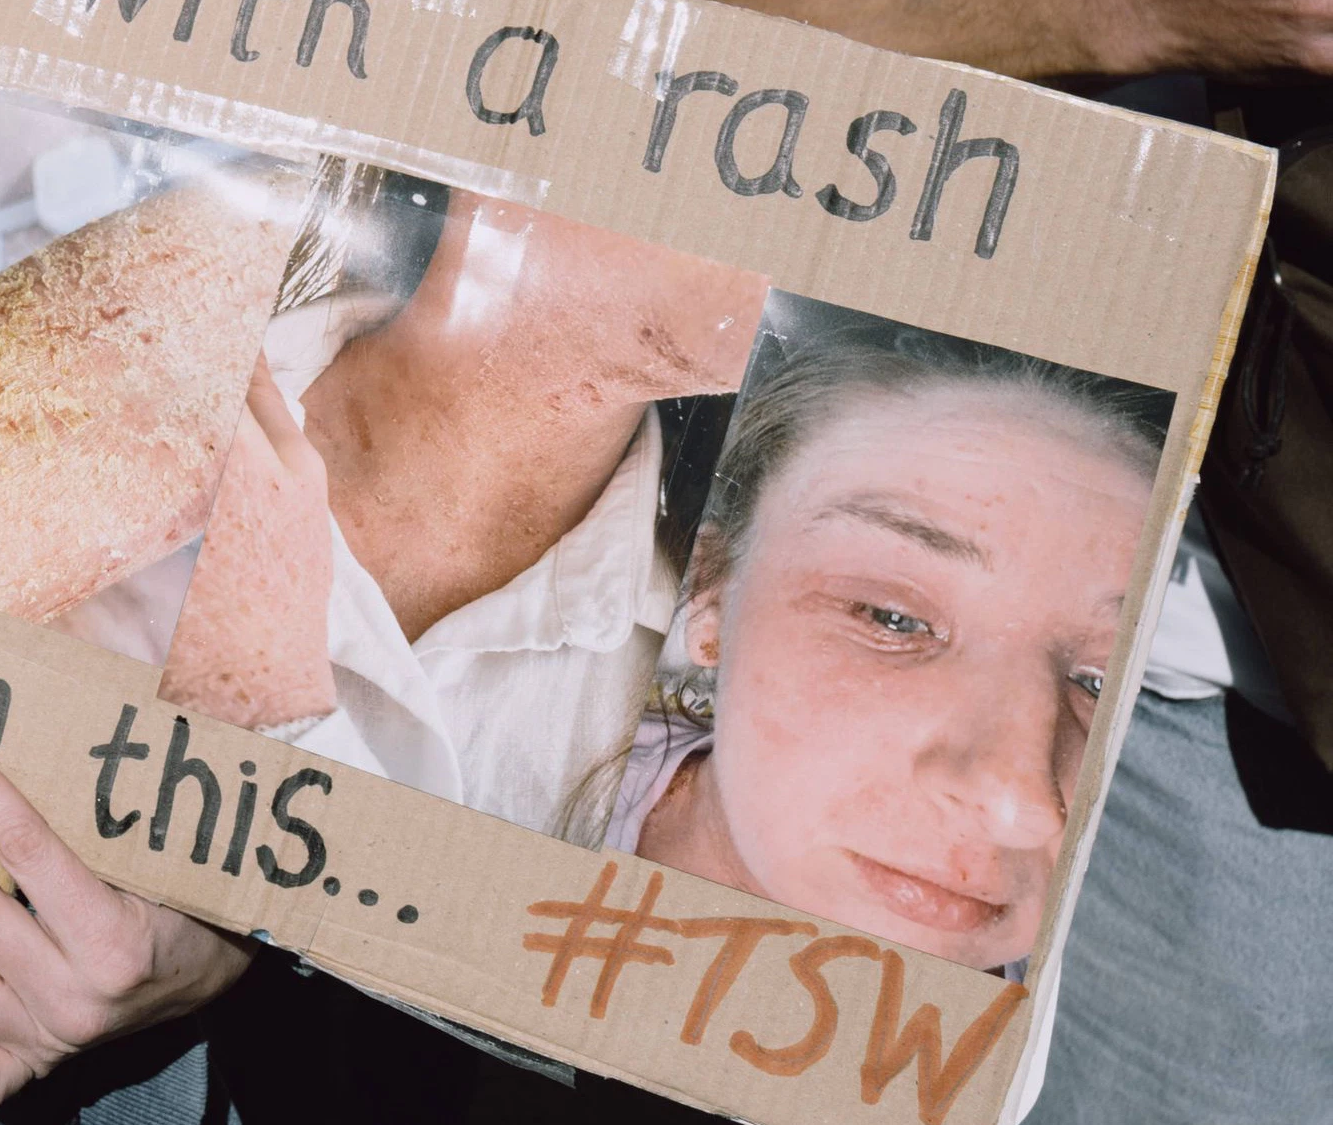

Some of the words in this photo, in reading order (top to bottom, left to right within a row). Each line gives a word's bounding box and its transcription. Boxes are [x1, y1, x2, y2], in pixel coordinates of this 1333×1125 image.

[464, 24, 560, 138] a
[641, 68, 1021, 260] rash
[88, 703, 420, 924] this...
[523, 860, 1030, 1125] #TSW
